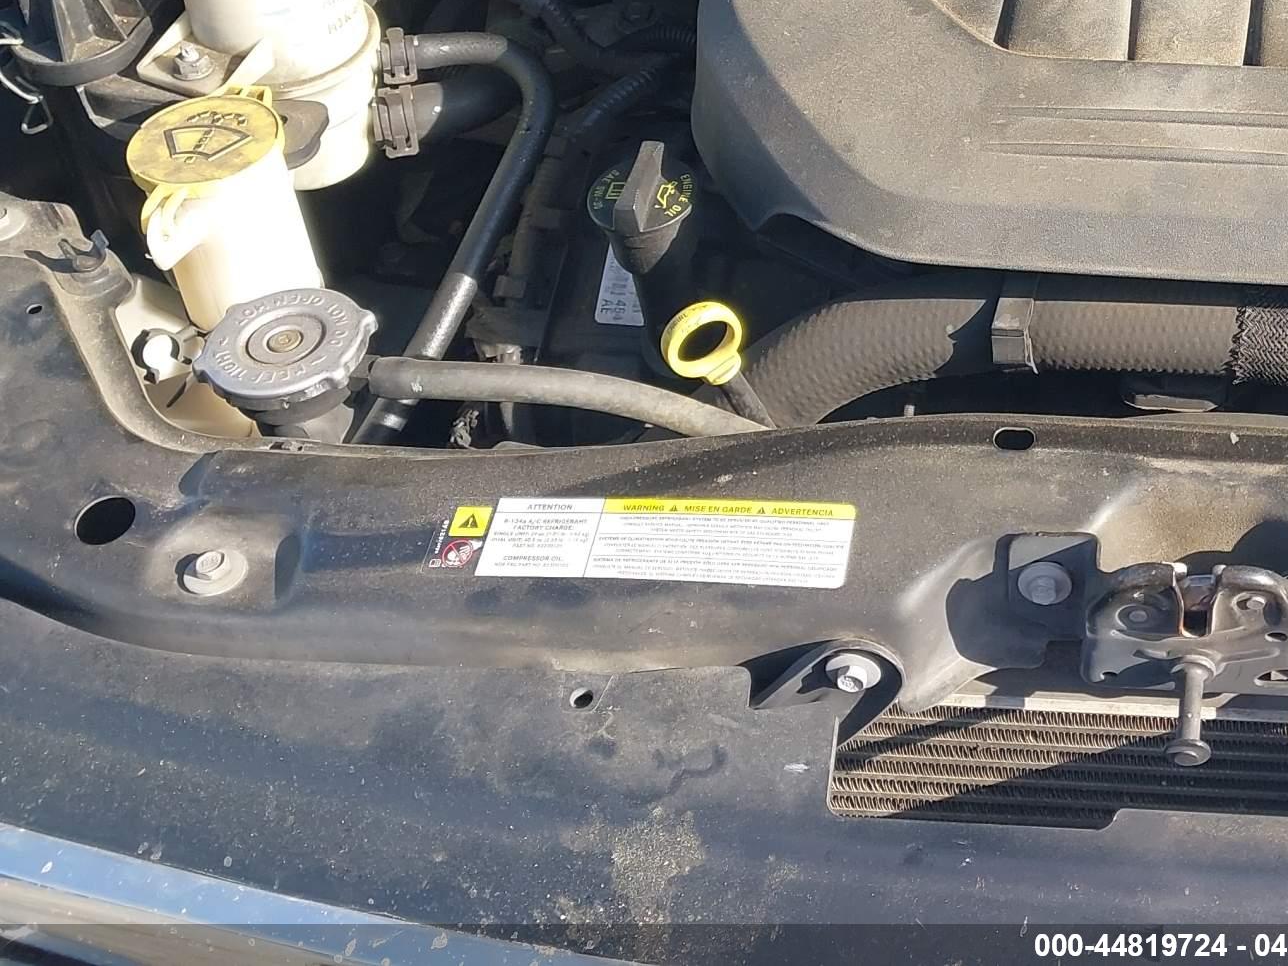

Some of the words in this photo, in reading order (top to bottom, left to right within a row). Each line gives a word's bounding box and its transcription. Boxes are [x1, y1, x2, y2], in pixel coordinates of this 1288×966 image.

[680, 173, 694, 204] ENGINE
[664, 204, 683, 218] OIL
[526, 503, 573, 511] ATTENTION
[623, 504, 665, 512] WARNING
[684, 505, 706, 513] MISE
[721, 505, 753, 514] GARDE
[770, 507, 834, 516] ADVERTENCIA
